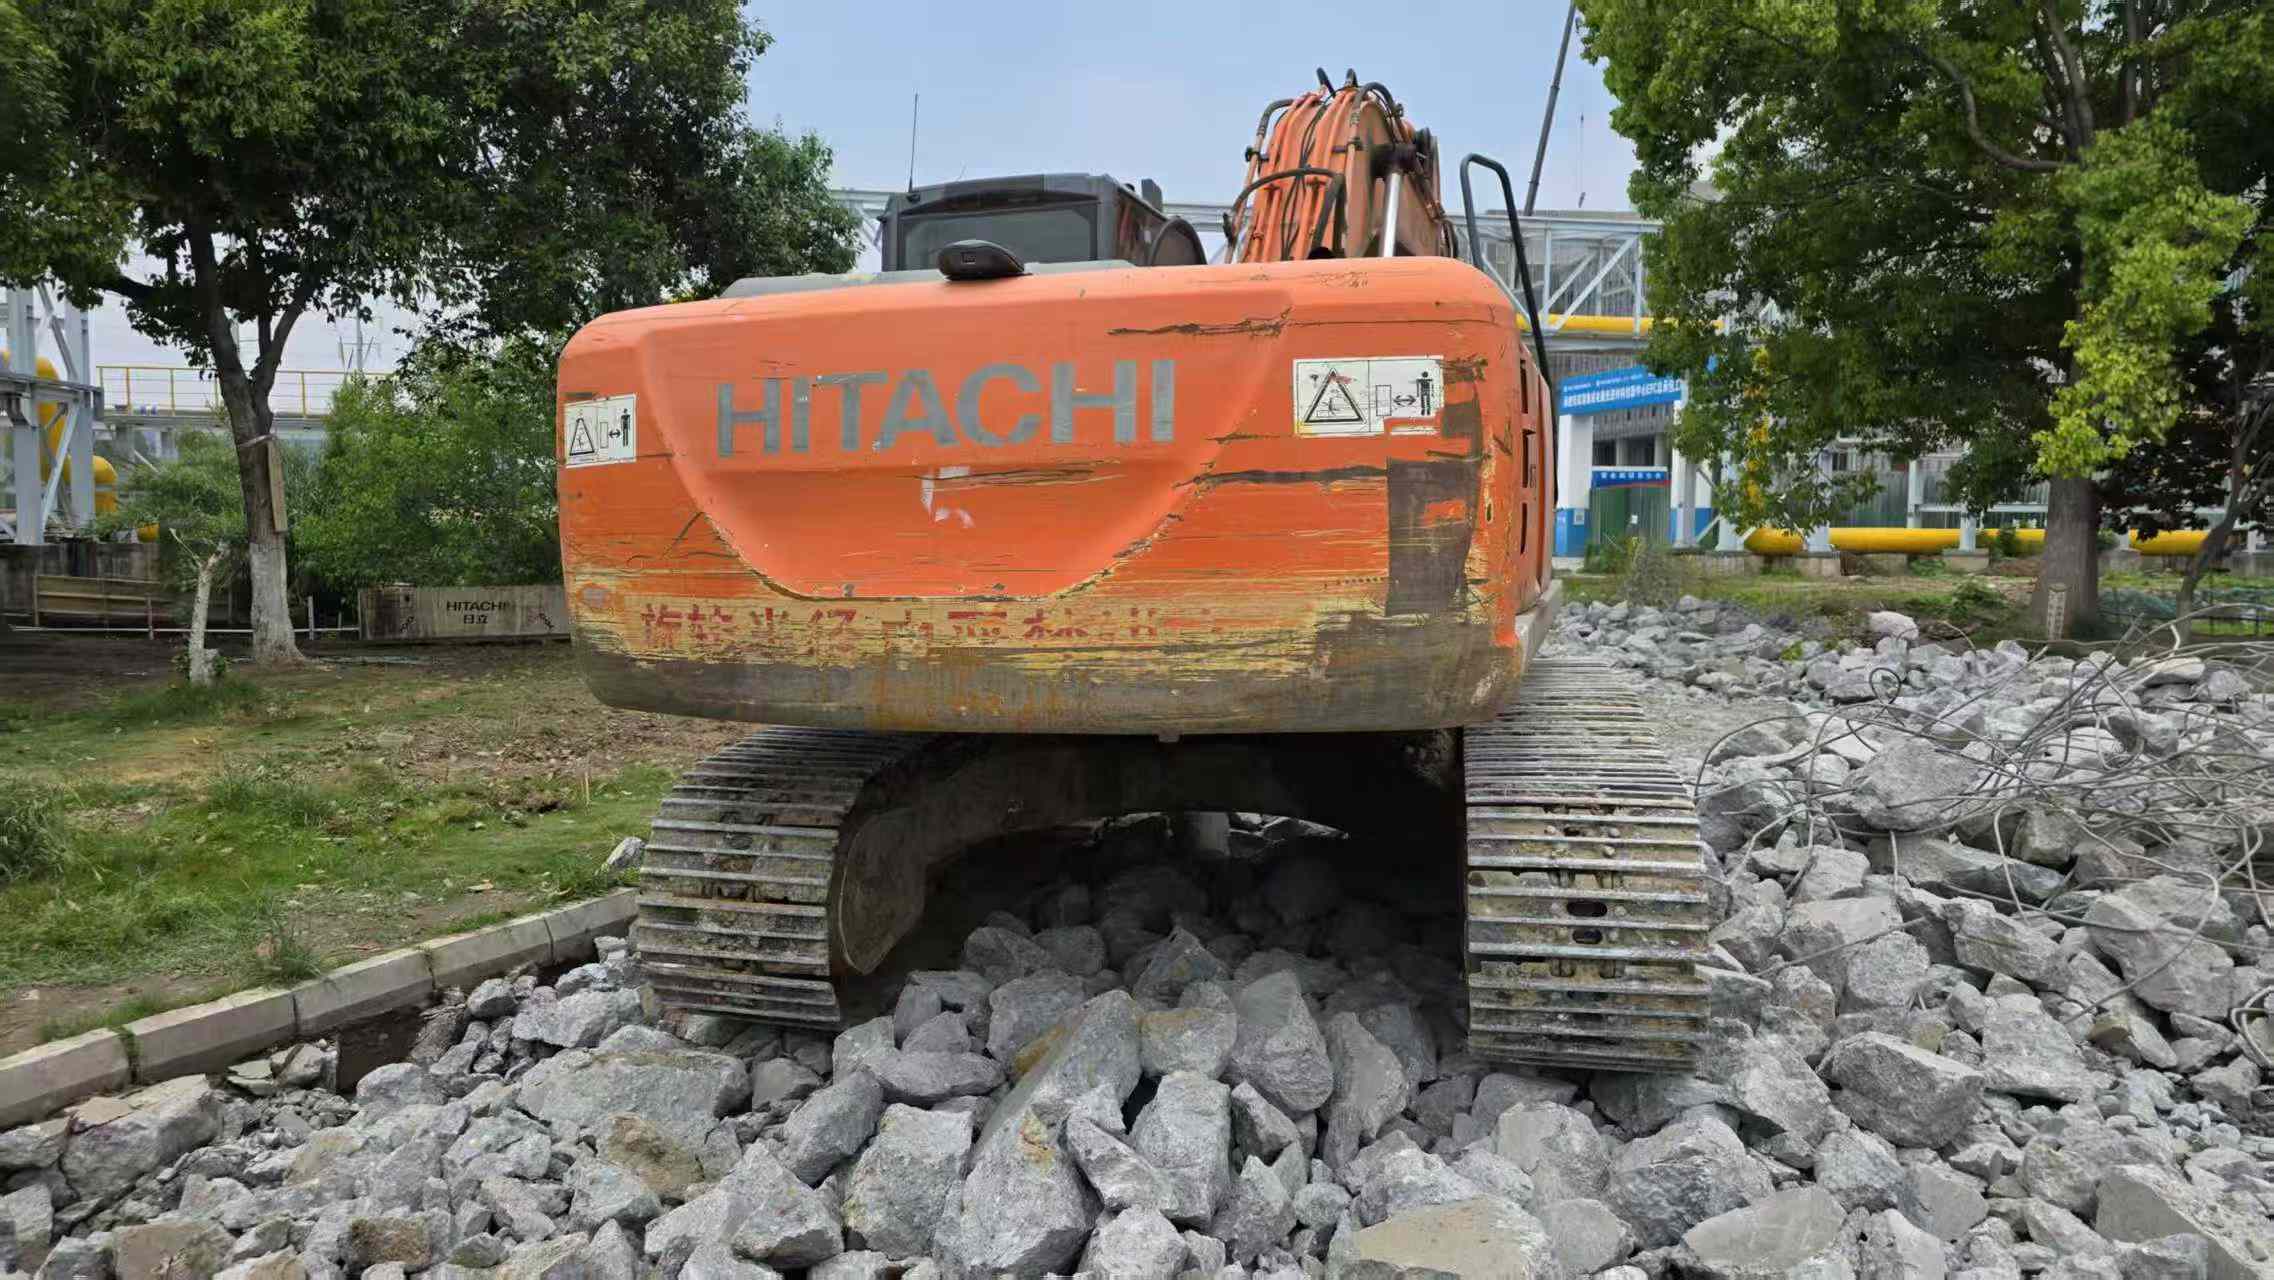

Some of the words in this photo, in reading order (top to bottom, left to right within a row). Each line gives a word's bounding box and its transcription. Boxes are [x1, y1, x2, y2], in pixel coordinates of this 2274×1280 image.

[718, 359, 1176, 456] HITACHI
[446, 601, 507, 611] HITACHI
[463, 614, 488, 625] 日立
